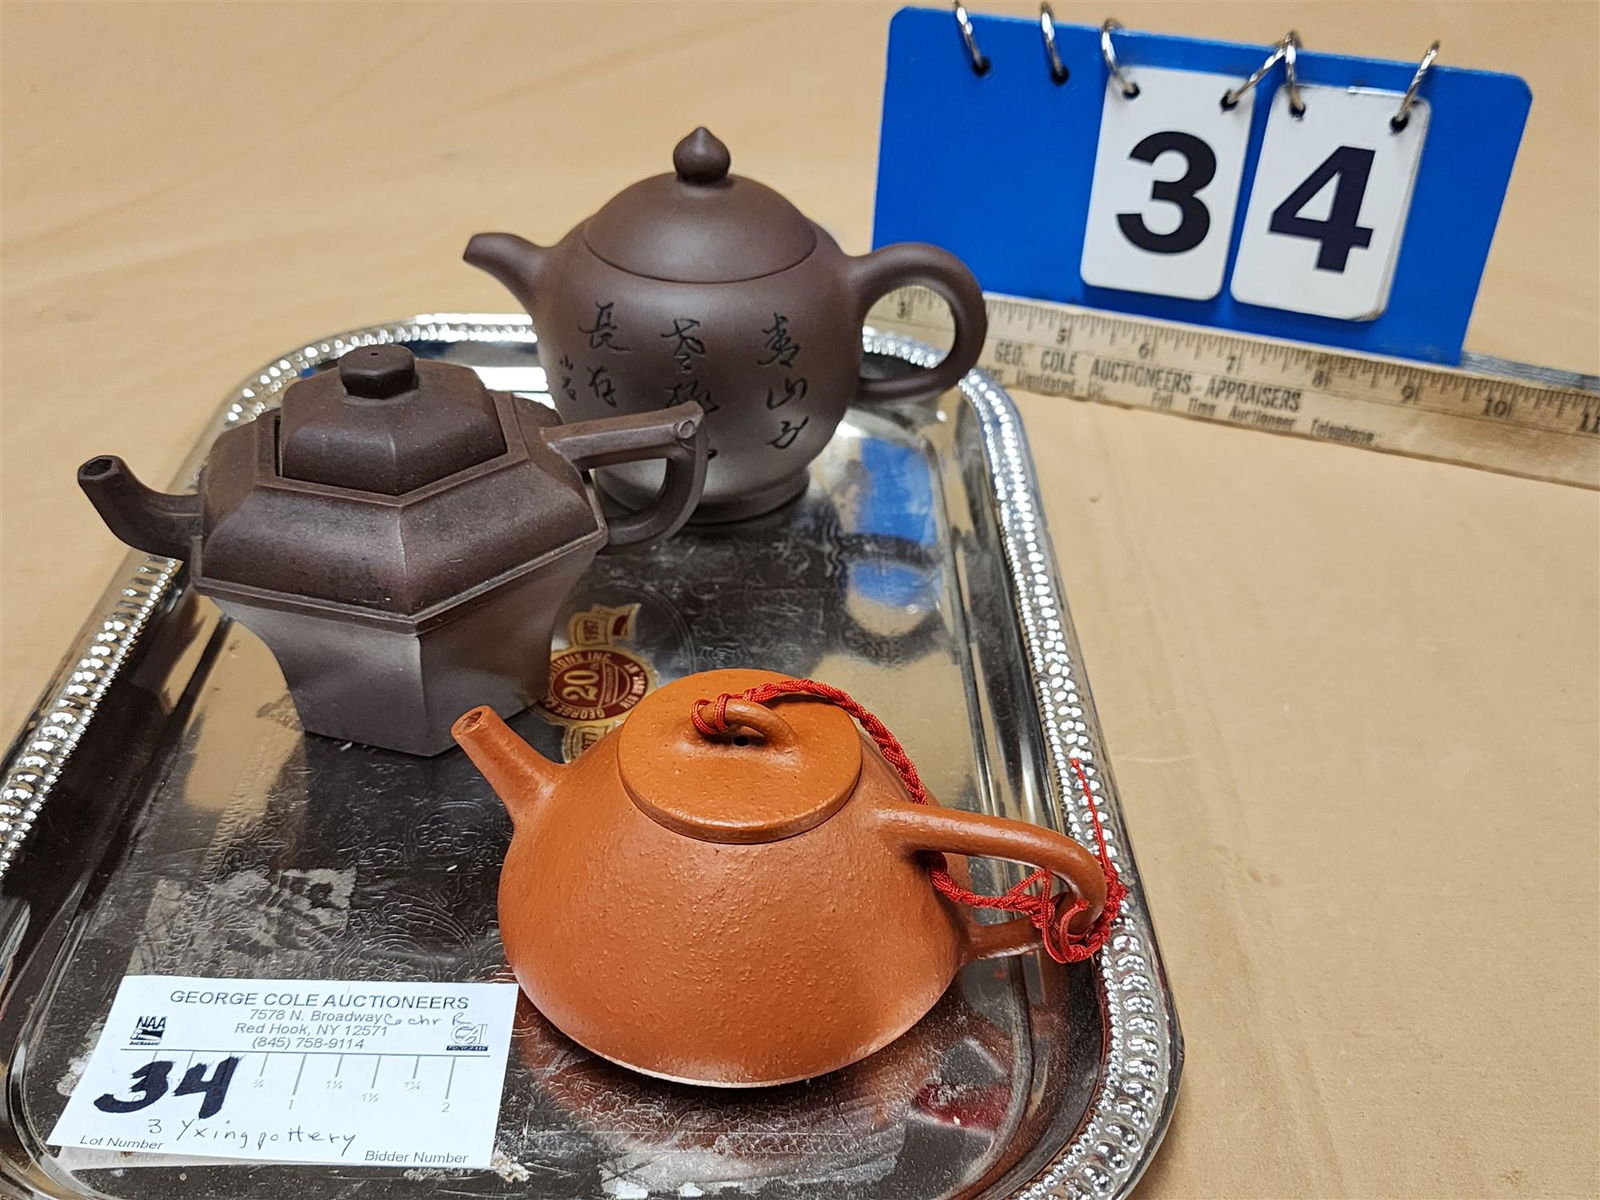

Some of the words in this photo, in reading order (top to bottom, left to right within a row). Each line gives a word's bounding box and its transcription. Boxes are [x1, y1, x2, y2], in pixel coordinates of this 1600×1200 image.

[1040, 350, 1078, 376] COLE
[1056, 327, 1067, 344] 5
[1138, 343, 1149, 359] 6
[1226, 356, 1236, 374] 7
[1312, 369, 1324, 387] 8
[1401, 384, 1415, 403] 9
[1482, 397, 1508, 417] 10
[562, 669, 600, 701] 20
[170, 990, 258, 1005] GEORGE
[264, 992, 320, 1007] COLE
[322, 993, 470, 1009] AUCTIONEERS
[136, 1015, 168, 1029] NAA
[250, 1009, 285, 1021] 7578
[290, 1010, 304, 1021] N.
[311, 1010, 385, 1025] Broadway
[234, 1022, 265, 1034] Red
[269, 1023, 311, 1036] Hook,
[316, 1025, 340, 1036] NY
[344, 1025, 389, 1037] 12571
[252, 1036, 291, 1050] (845)
[296, 1037, 365, 1050] 758-9114
[94, 1055, 243, 1119] 34
[441, 1102, 451, 1113] 2
[148, 1118, 162, 1134] 3
[80, 1135, 102, 1147] Lot
[106, 1137, 165, 1150] Number
[364, 1150, 410, 1162] Bidder
[413, 1152, 469, 1164] Number
